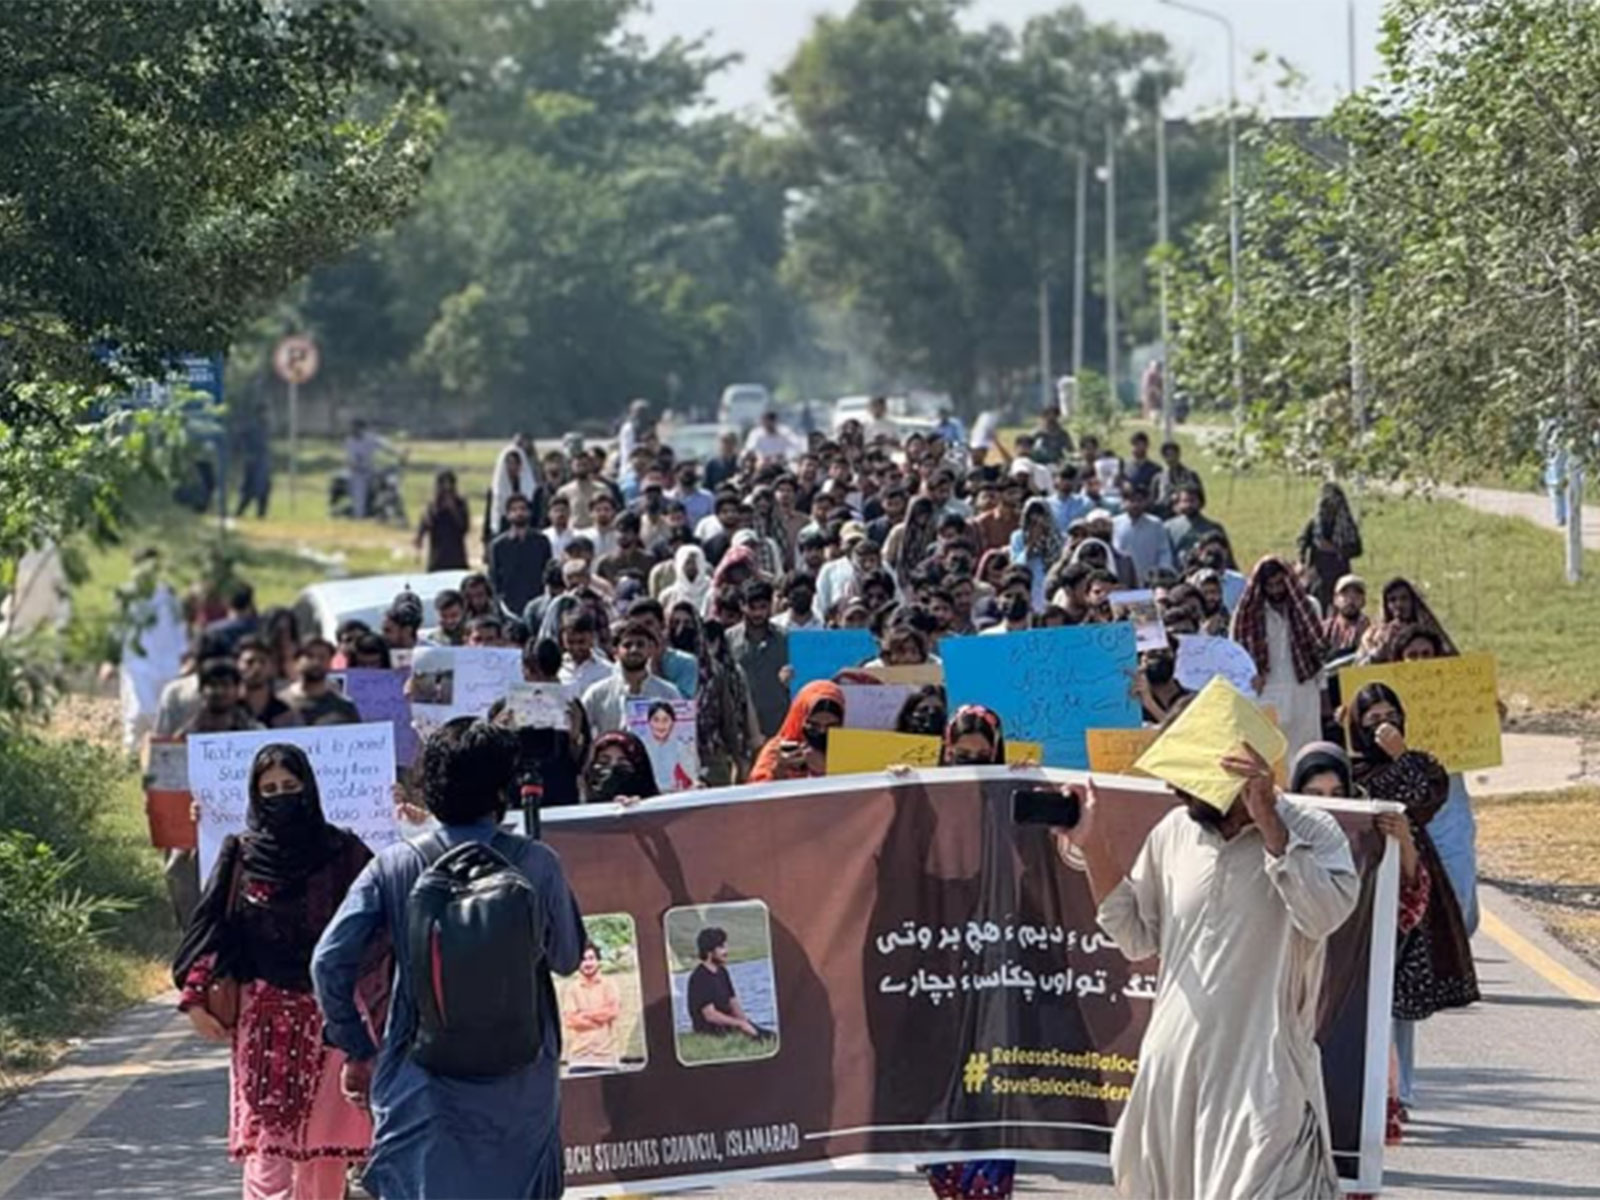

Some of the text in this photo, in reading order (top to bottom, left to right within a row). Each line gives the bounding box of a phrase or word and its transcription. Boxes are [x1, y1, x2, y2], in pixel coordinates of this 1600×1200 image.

[991, 1075, 1132, 1101] SaveBalochStuden
[562, 1121, 800, 1176] OCH STUDENTS COUNCIL, ISLAMABAD
